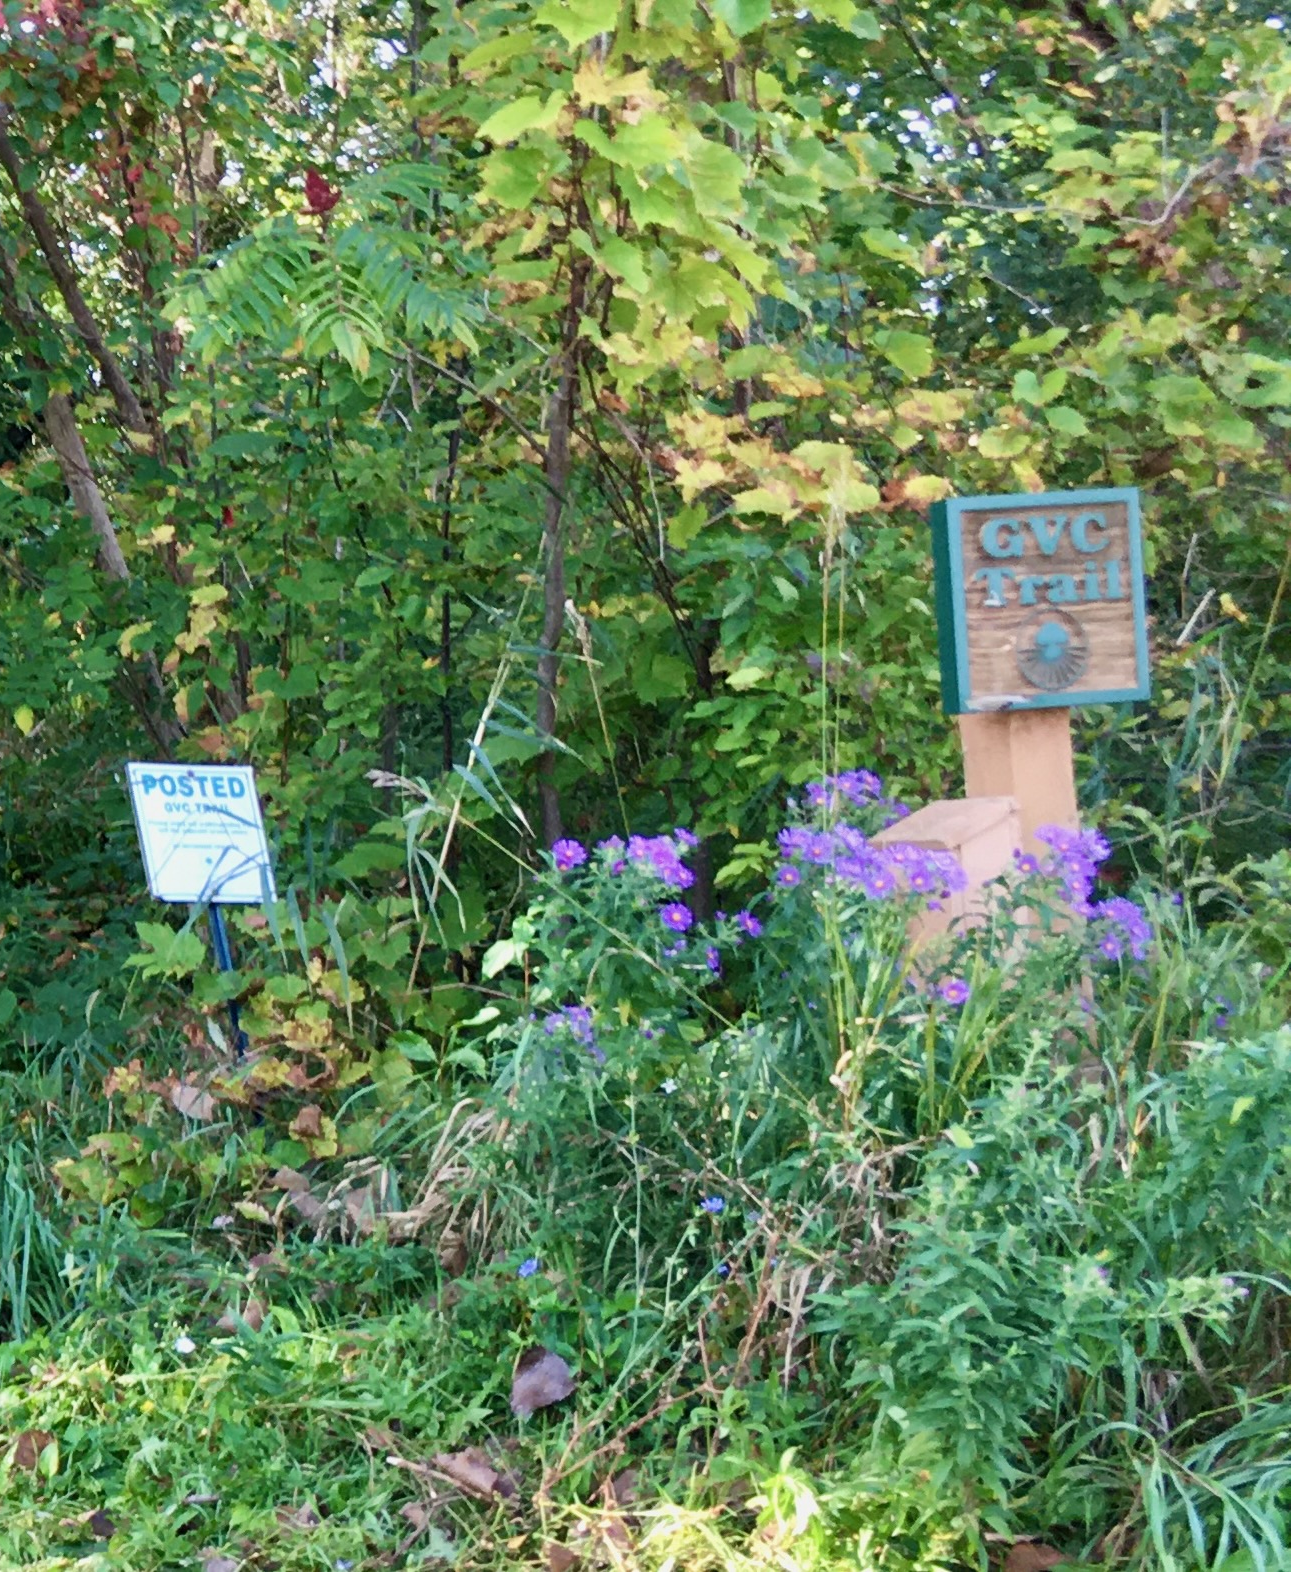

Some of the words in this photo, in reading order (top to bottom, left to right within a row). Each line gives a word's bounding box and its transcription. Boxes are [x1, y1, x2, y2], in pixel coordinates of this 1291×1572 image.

[980, 512, 1110, 559] GVC
[973, 560, 1123, 607] Trail
[142, 774, 245, 798] POSTED
